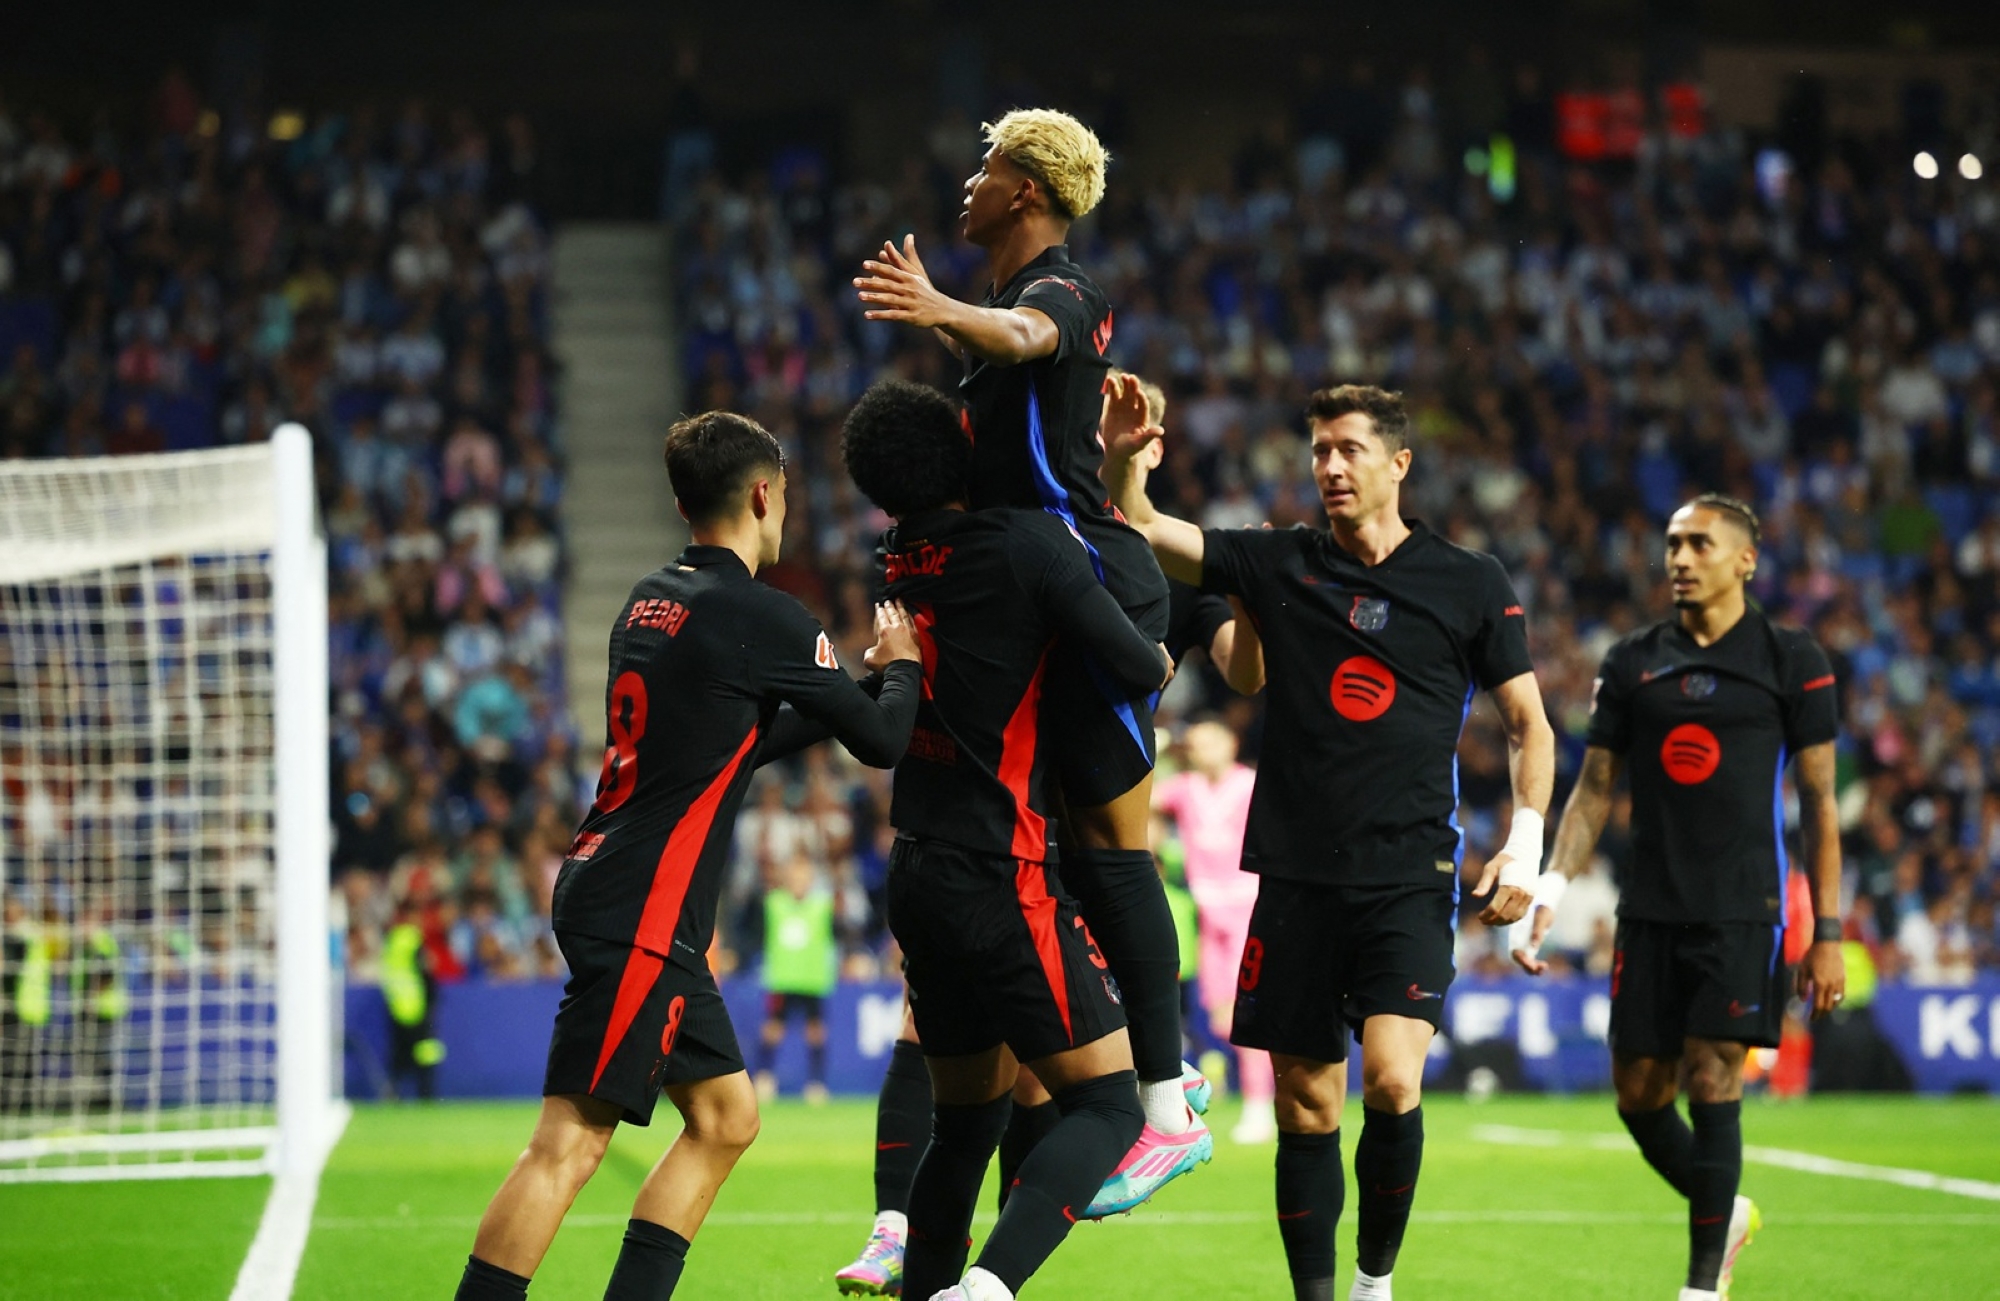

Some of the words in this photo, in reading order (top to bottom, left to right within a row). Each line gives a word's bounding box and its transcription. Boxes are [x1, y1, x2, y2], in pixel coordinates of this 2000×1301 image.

[626, 598, 690, 637] PEDRI
[594, 671, 648, 814] 8
[1073, 914, 1110, 970] 3
[1240, 935, 1265, 992] 9
[661, 994, 686, 1056] 8
